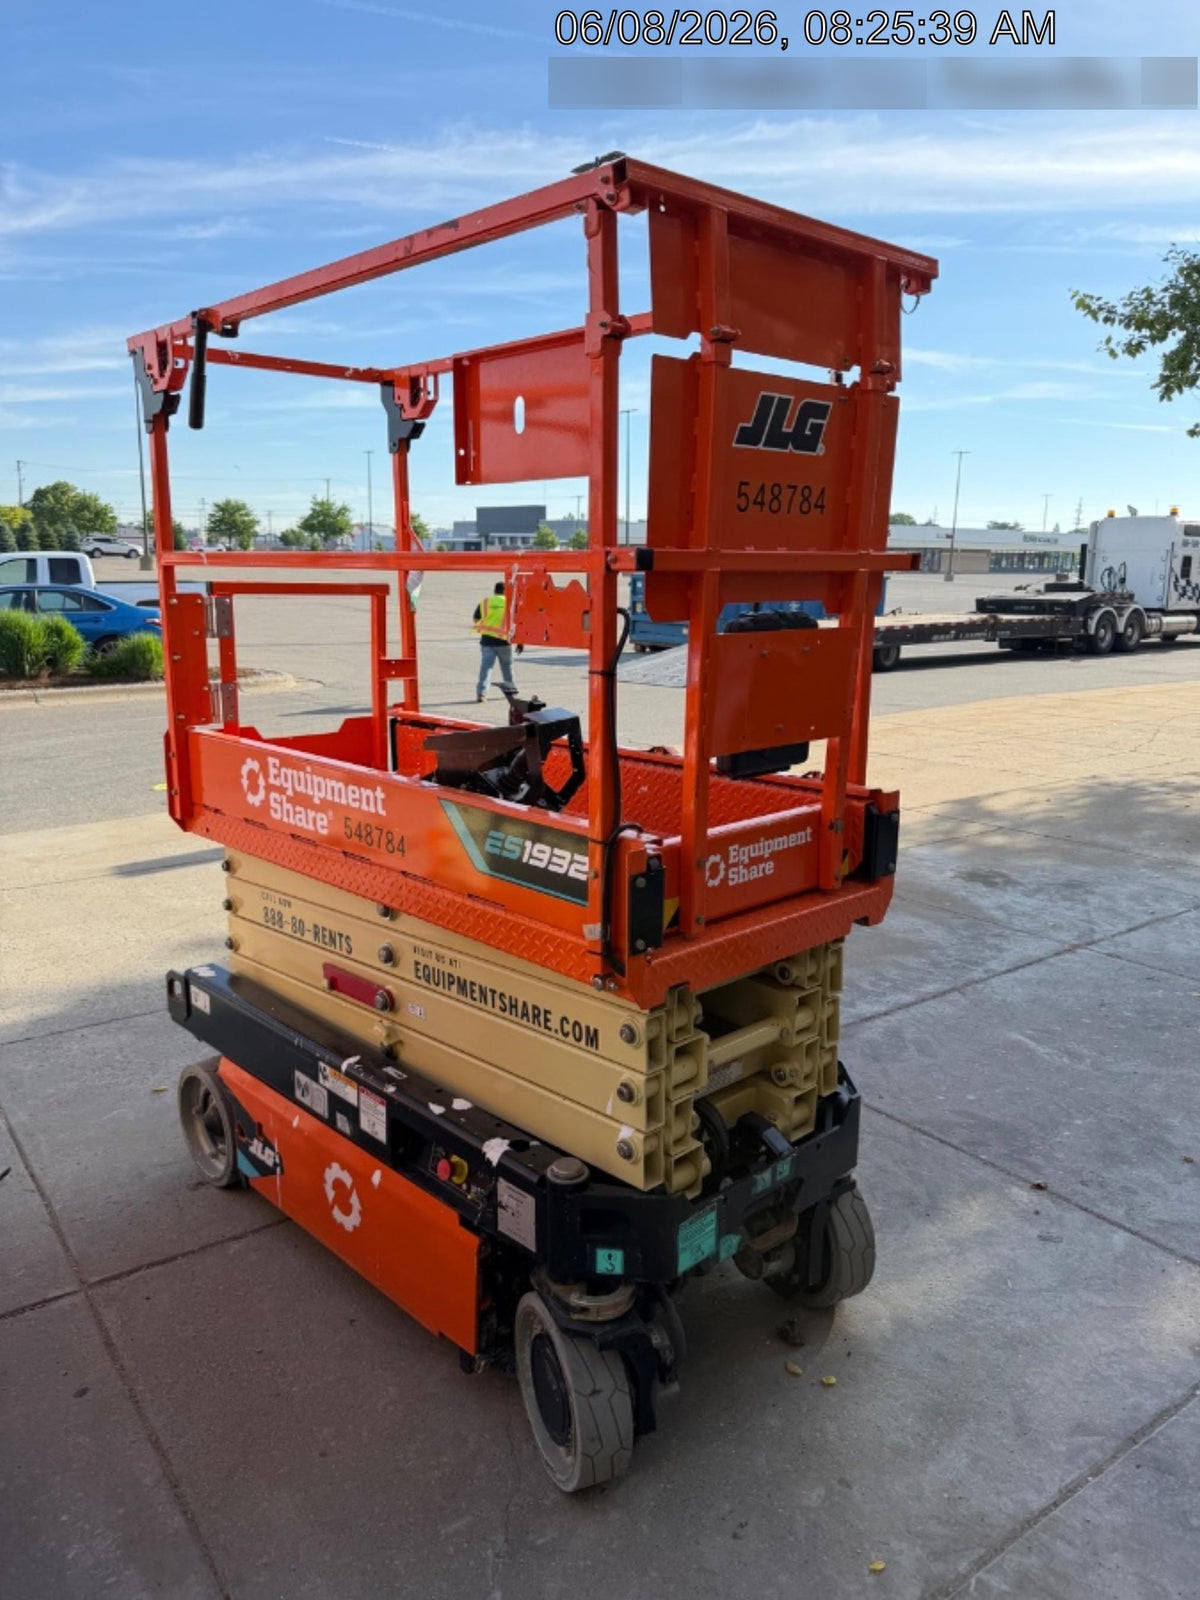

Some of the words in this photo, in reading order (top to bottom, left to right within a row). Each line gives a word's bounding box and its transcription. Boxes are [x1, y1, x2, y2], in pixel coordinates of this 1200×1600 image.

[732, 391, 832, 456] JLG
[736, 481, 826, 515] 548784
[267, 756, 387, 817] Equipment
[269, 791, 329, 836] Share
[344, 816, 406, 857] 548784
[484, 830, 589, 881] ES1932
[728, 826, 812, 865] Equipment
[728, 860, 775, 886] Share
[263, 906, 353, 955] 888-80-RENTS
[413, 945, 434, 961] VISIT
[435, 952, 446, 965] US
[413, 960, 600, 1051] EQUIPMENTSHARE.COM
